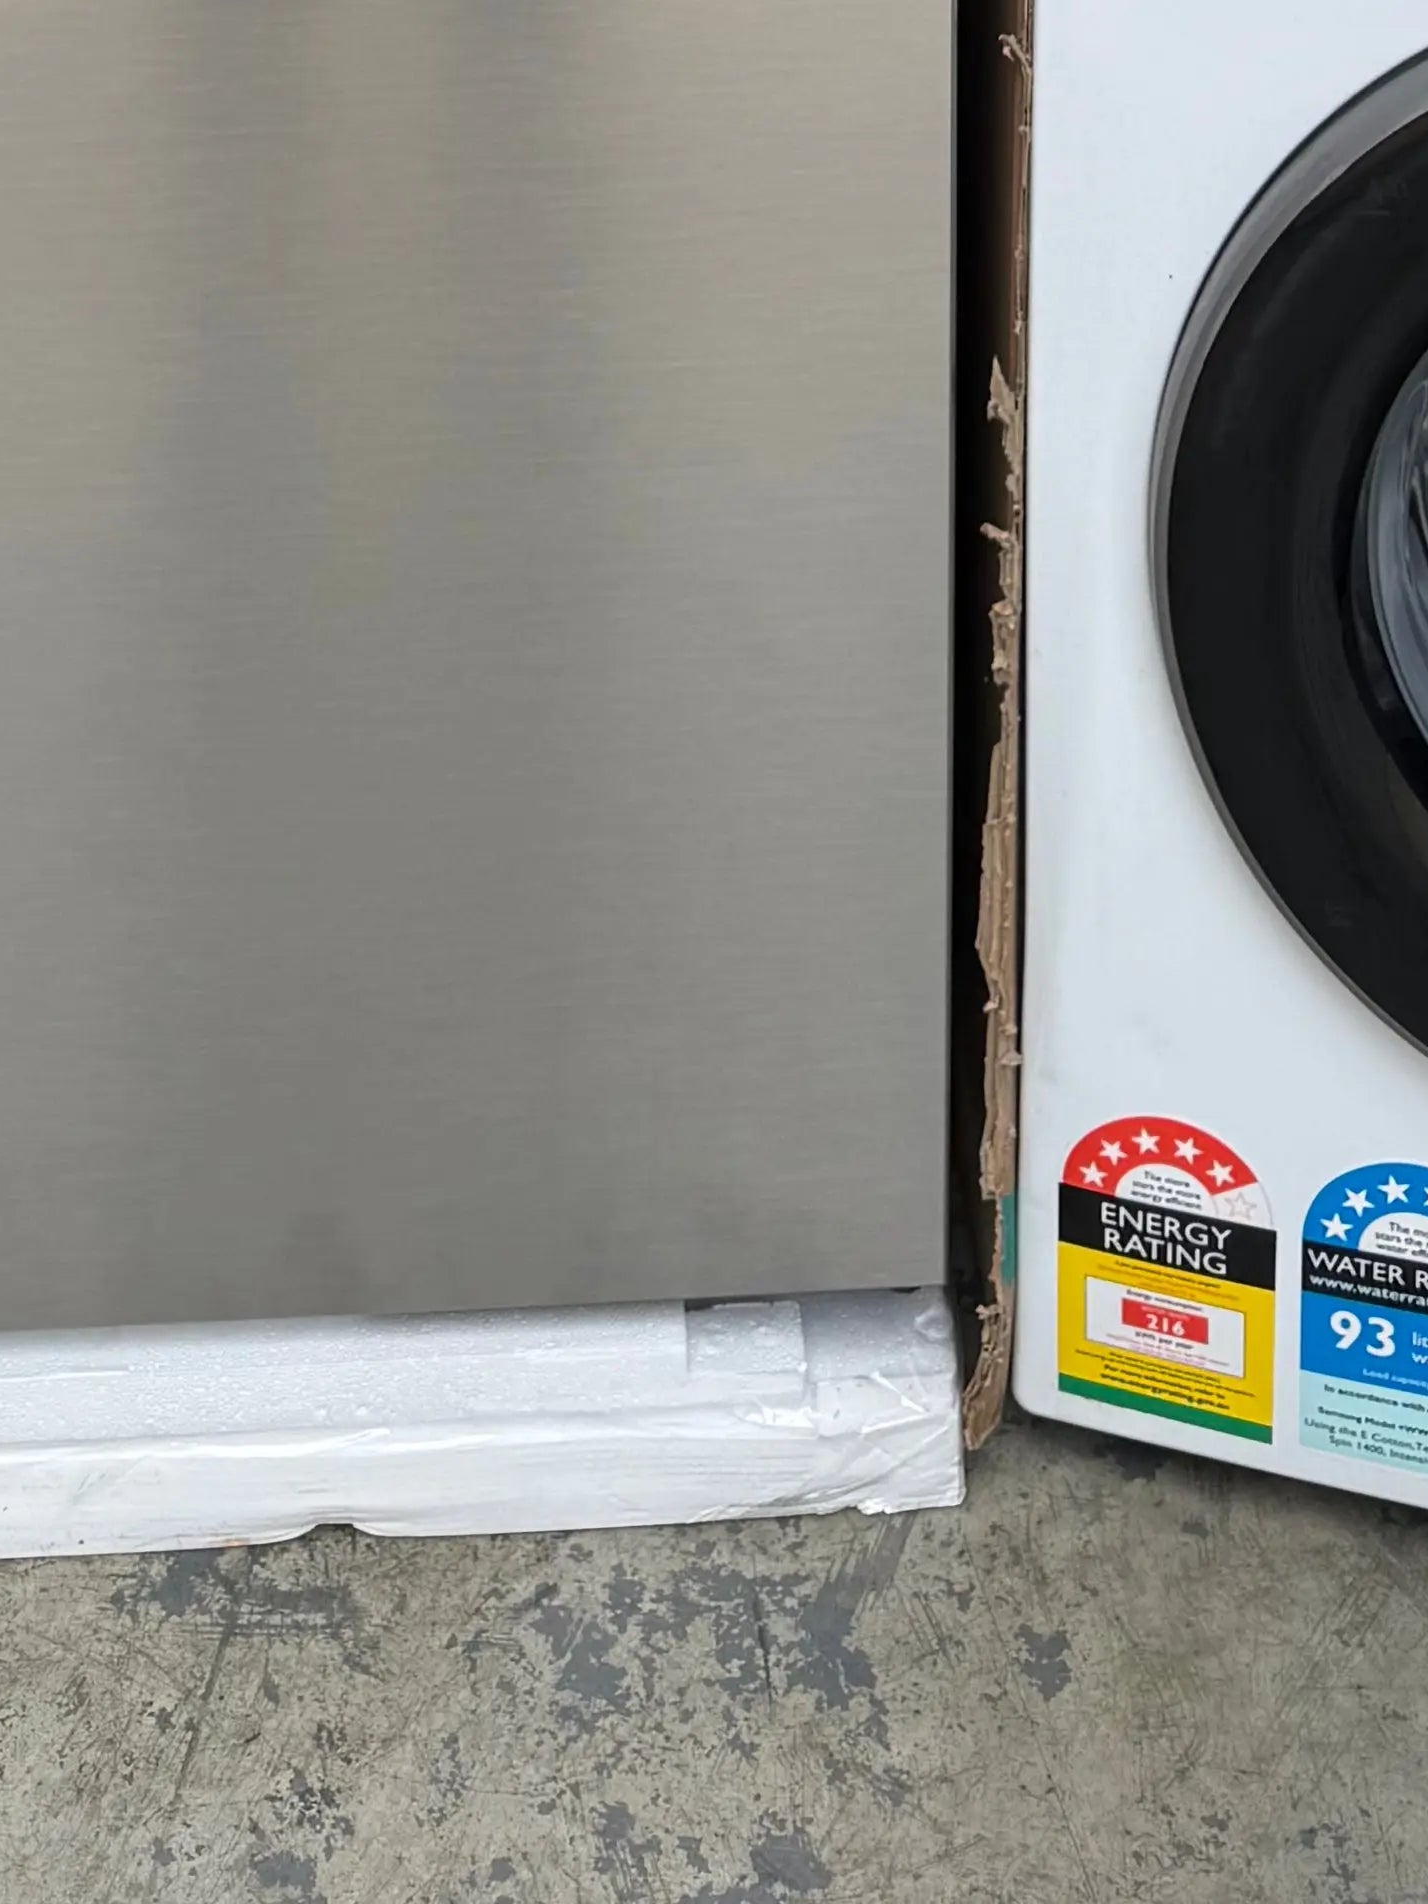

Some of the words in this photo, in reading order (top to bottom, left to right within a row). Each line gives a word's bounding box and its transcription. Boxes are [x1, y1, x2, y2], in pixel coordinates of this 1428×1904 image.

[1101, 1201, 1232, 1250] ENERGY
[1389, 1221, 1410, 1234] The
[1104, 1228, 1227, 1275] RATING
[1375, 1232, 1401, 1243] stars
[1405, 1236, 1423, 1248] the
[1375, 1243, 1408, 1255] water
[1307, 1248, 1405, 1286] WATER
[1145, 1313, 1185, 1336] 216
[1330, 1310, 1396, 1357] 93
[1338, 1388, 1399, 1407] accordance
[1401, 1400, 1426, 1413] with
[1304, 1417, 1335, 1435] Using
[1338, 1424, 1357, 1438] the
[1329, 1435, 1352, 1450] Spin
